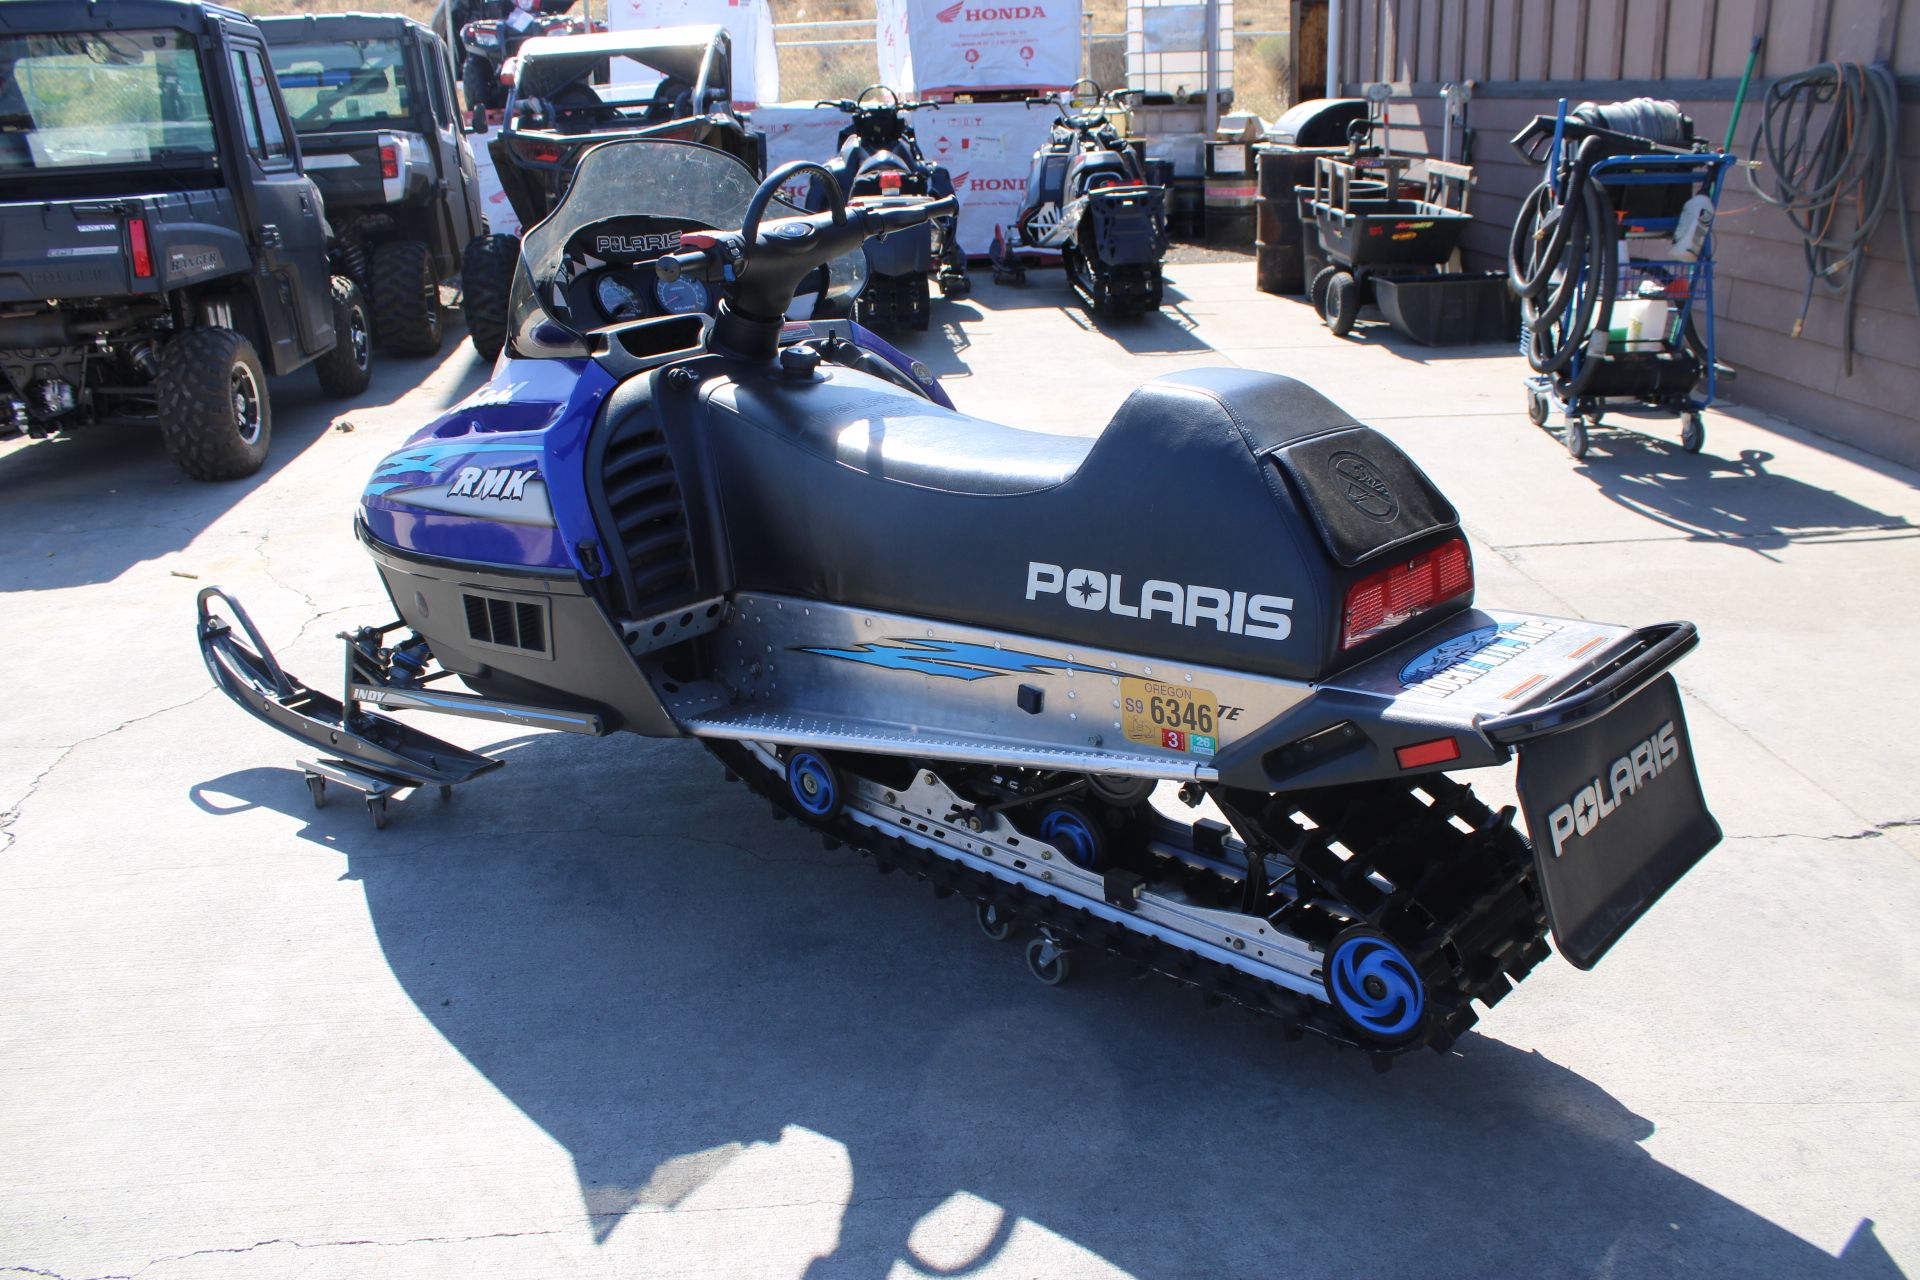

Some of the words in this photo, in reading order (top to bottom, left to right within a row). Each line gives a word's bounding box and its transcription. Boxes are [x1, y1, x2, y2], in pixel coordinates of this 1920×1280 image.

[965, 6, 1046, 21] HONDA
[596, 231, 683, 253] POLARIS
[170, 251, 218, 272] RANGER
[447, 466, 538, 501] RMK
[1025, 561, 1295, 641] POLARIS
[1144, 682, 1192, 700] OREGON
[1401, 661, 1491, 699] ROCKY
[353, 688, 386, 703] INDY
[1125, 697, 1144, 714] S9
[1150, 695, 1213, 734] 6346
[1168, 731, 1179, 748] 3
[1548, 720, 1680, 858] POLARIS
